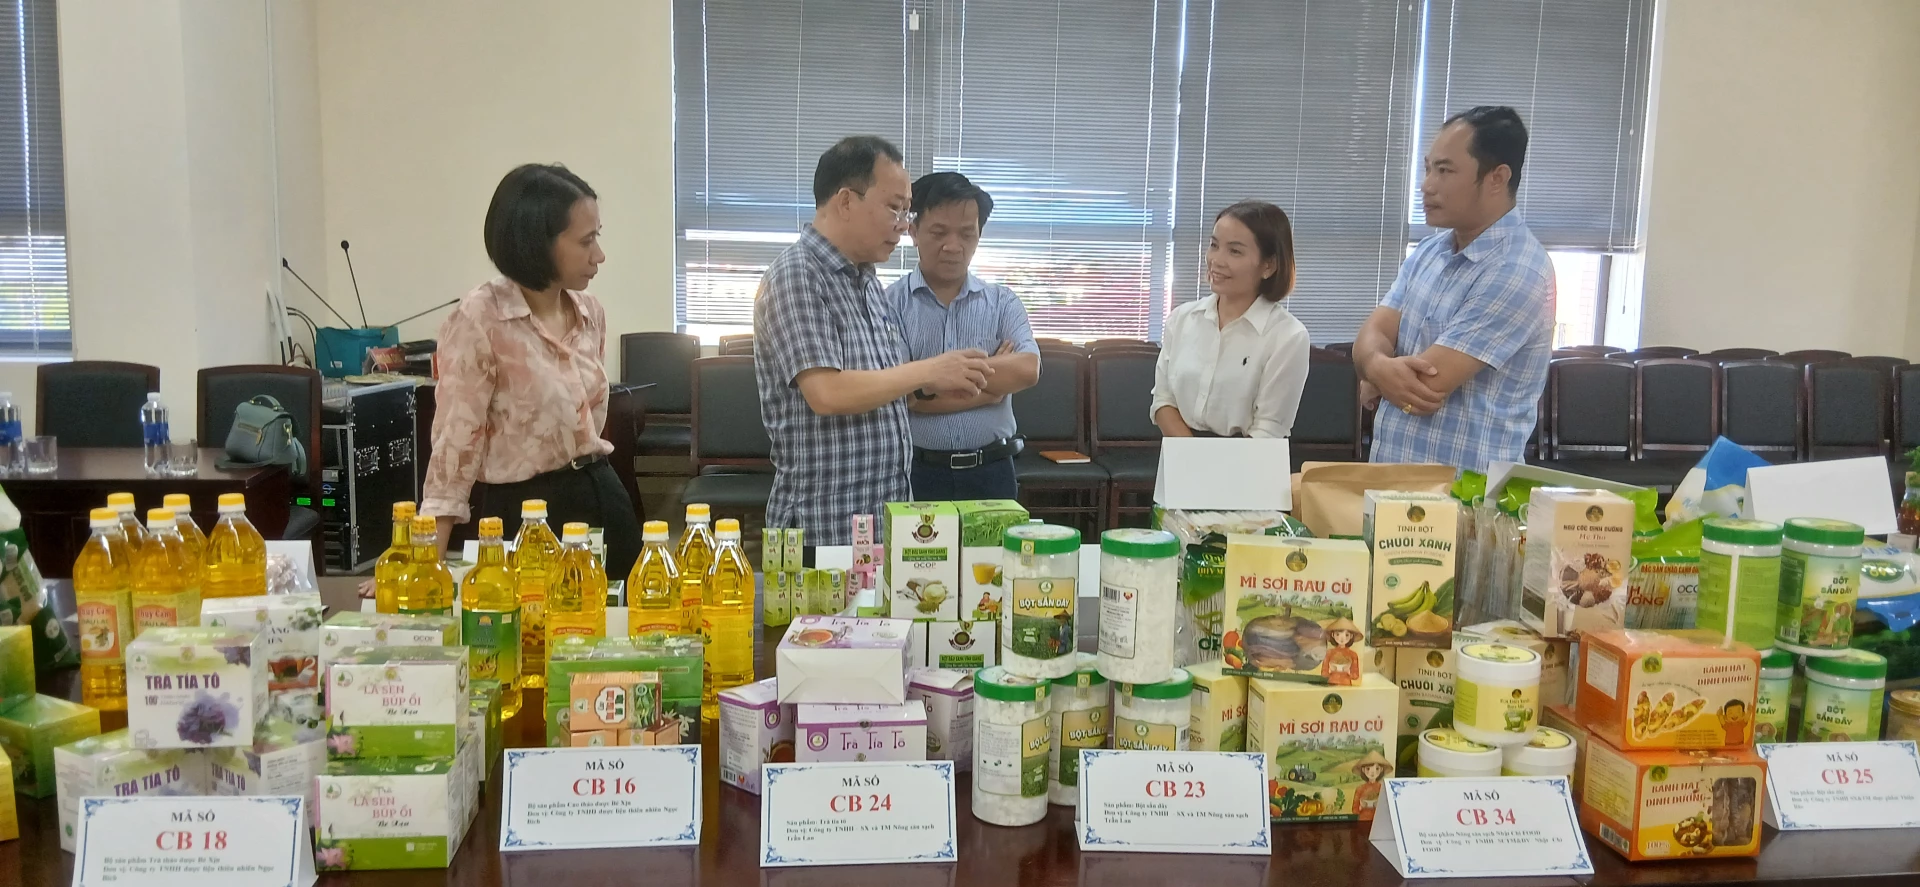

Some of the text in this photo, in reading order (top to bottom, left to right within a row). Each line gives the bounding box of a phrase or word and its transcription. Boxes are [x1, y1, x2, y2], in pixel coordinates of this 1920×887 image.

[1397, 525, 1434, 534] TINH BỘT
[1418, 538, 1452, 552] XANH
[1240, 573, 1352, 595] MÌ SỢI RAU CỦ
[1677, 584, 1698, 594] OCO
[1019, 597, 1071, 610] BỘT SẮN DÂY
[1418, 668, 1452, 680] TINH BỘT
[1703, 664, 1729, 675] BÁNH
[145, 672, 220, 690] TRÀ TÍA TÔ
[1697, 677, 1720, 687] DINH
[381, 685, 405, 695] SEN
[1438, 684, 1455, 696] XA
[1222, 706, 1233, 722] MÌ
[1760, 706, 1776, 715] DÂY
[1279, 716, 1383, 737] MÌ SỢI RAU CỦ
[1834, 716, 1853, 726] DÂY
[840, 730, 905, 751] Trà Tía Tô
[1069, 729, 1087, 741] BỘT
[1119, 737, 1133, 749] BỘT
[1826, 752, 1858, 762] MÃ SỐ
[585, 758, 625, 771] MÃ SỐ
[1157, 762, 1194, 773] MÃ SỐ
[114, 764, 181, 797] TRÀ TÍA TÔ
[237, 774, 246, 791] TÔ
[842, 774, 880, 787] MÃ SỐ
[1821, 768, 1874, 785] CB 25
[572, 777, 637, 796] CB 16
[1146, 780, 1206, 798] CB 23
[372, 797, 395, 806] SEN
[1463, 789, 1500, 801] MÃ SỐ
[829, 793, 892, 813] CB 24
[1646, 797, 1671, 807] DINH
[171, 808, 216, 822] MÃ SỐ
[1456, 808, 1516, 826] CB 34
[156, 830, 228, 851] CB 18
